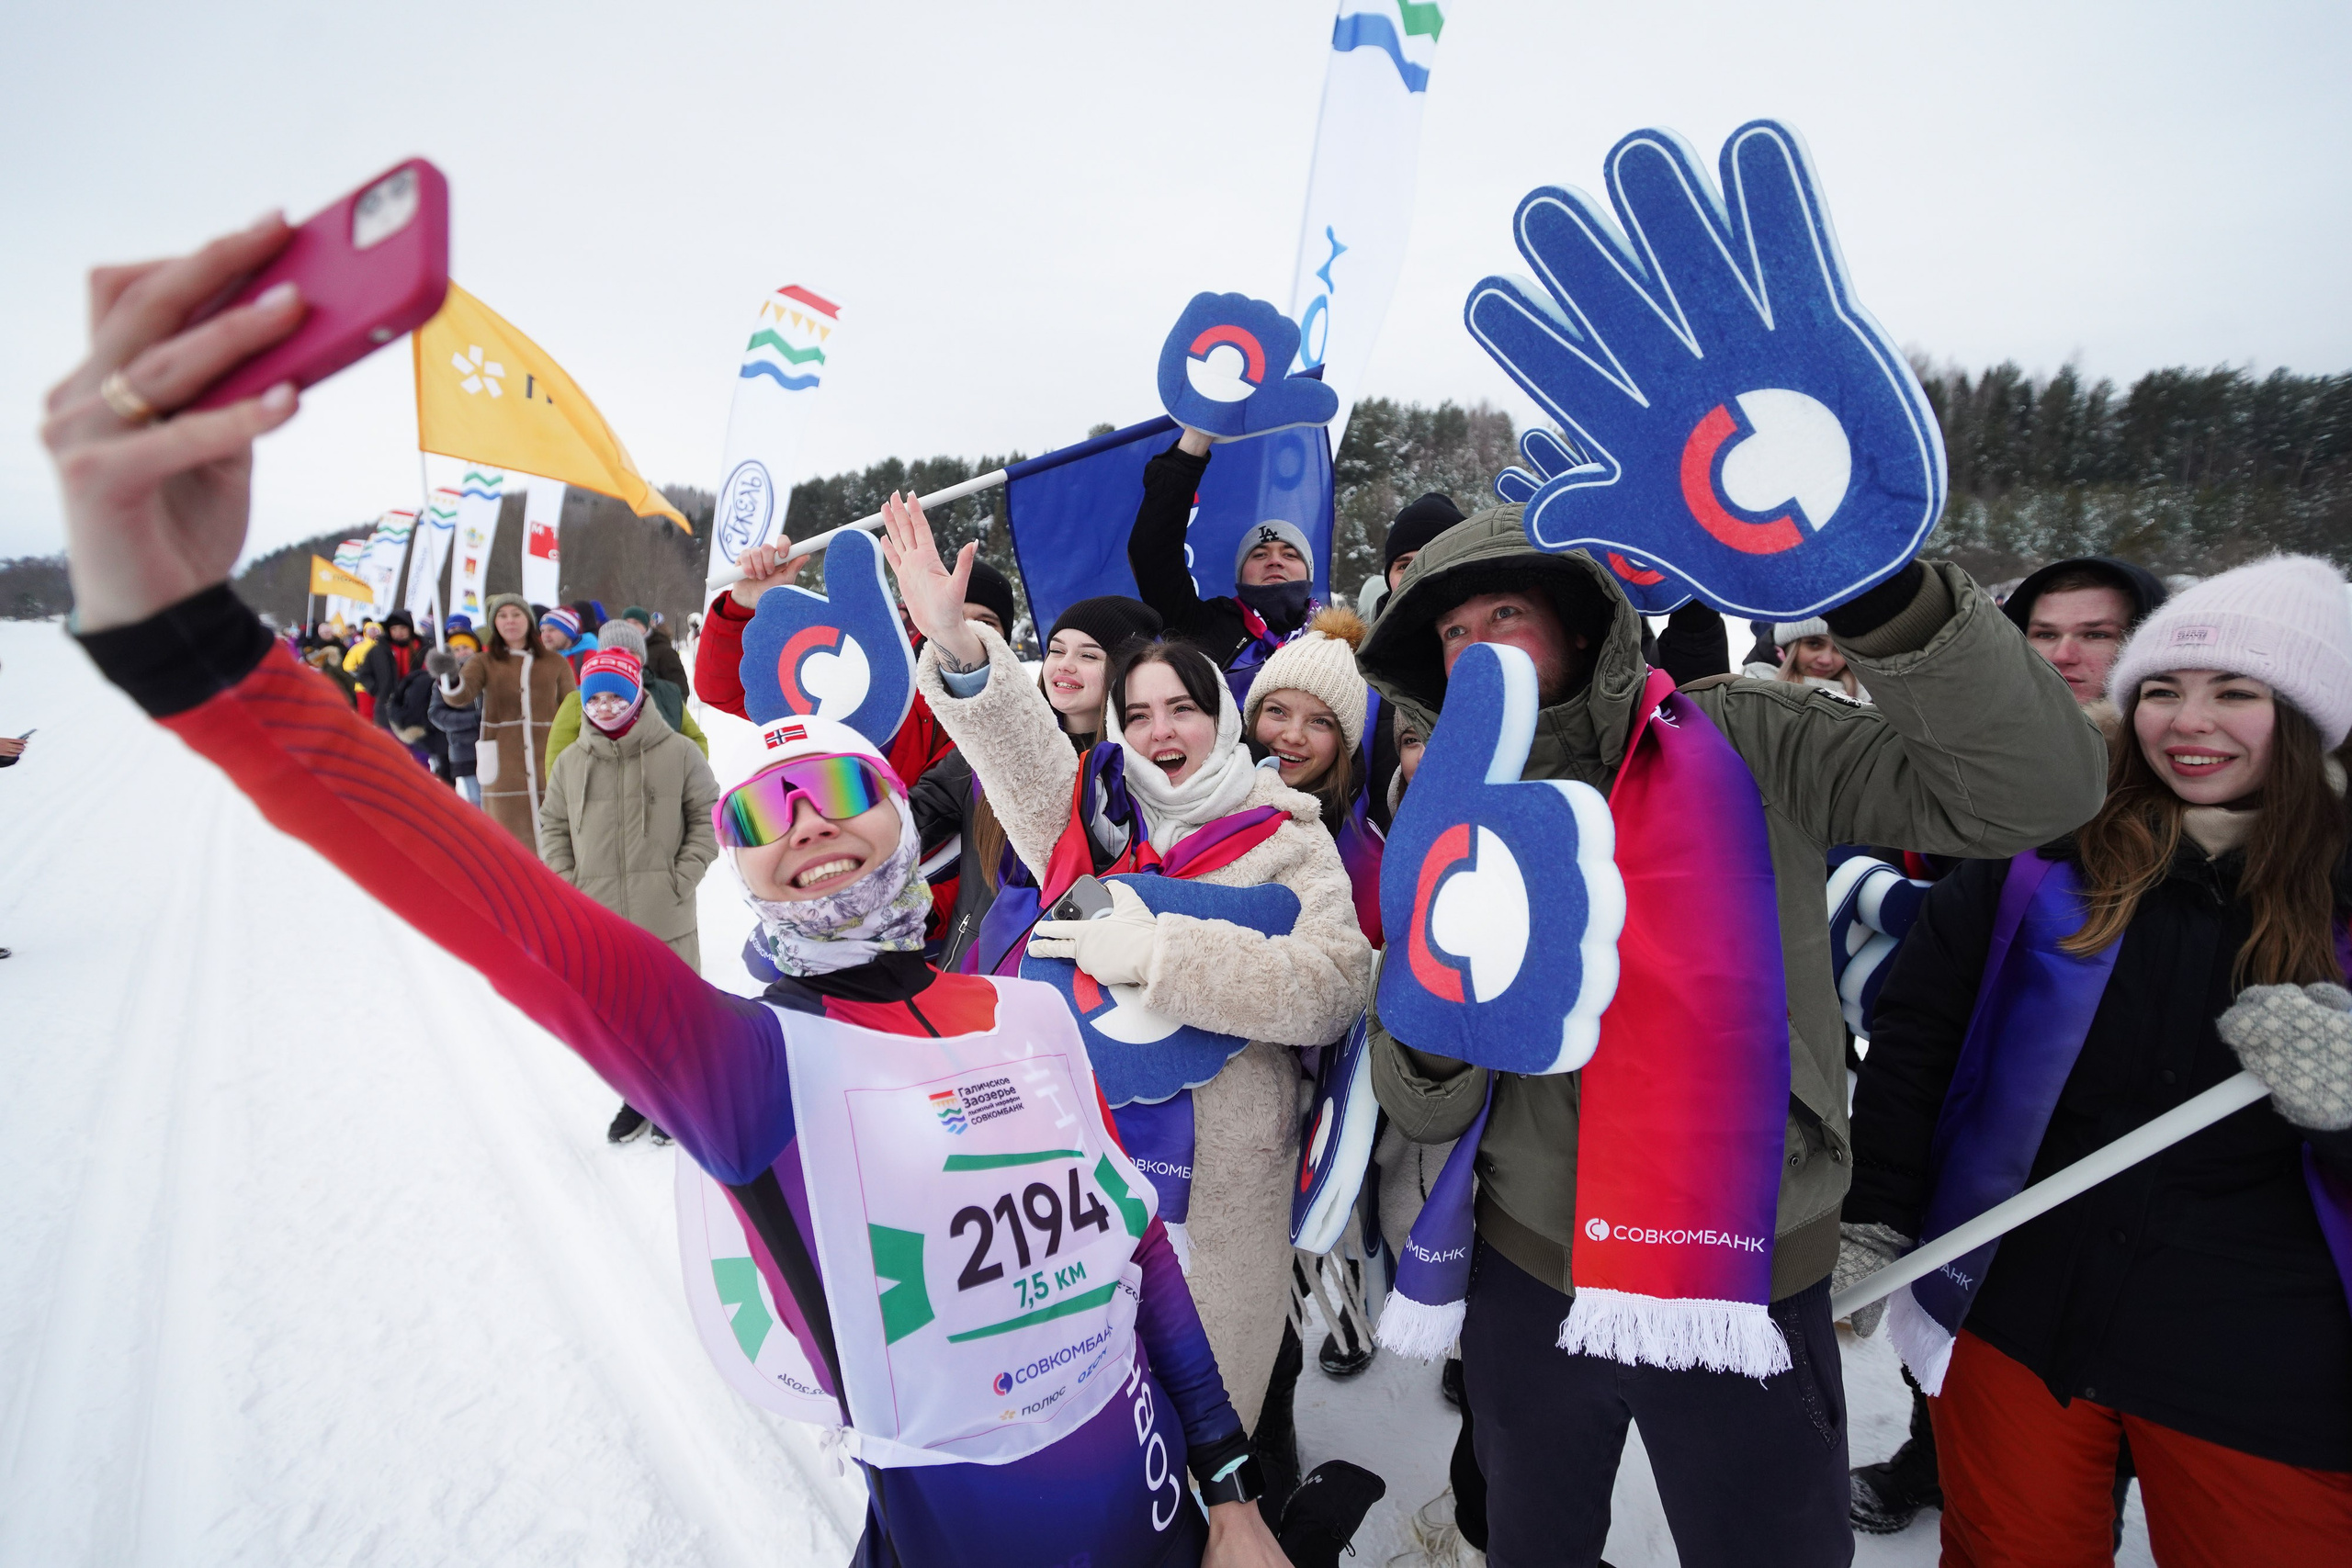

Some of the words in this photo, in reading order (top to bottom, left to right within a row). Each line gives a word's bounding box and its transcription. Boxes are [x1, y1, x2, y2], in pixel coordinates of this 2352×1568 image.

[1259, 525, 1279, 542] LA
[957, 1077, 1011, 1098] Галичское
[962, 1086, 1016, 1109] Заозерье
[967, 1103, 994, 1116] лыжный
[995, 1096, 1021, 1108] марафон
[971, 1102, 1024, 1125] СОВКОМБАНК
[1129, 1156, 1193, 1179] ВКОМБ
[950, 1168, 1109, 1292] 2194
[1613, 1224, 1766, 1253] СОВКОМБАНК
[1013, 1271, 1049, 1309] 7,5
[1022, 1385, 1066, 1416] ПОЛЮС
